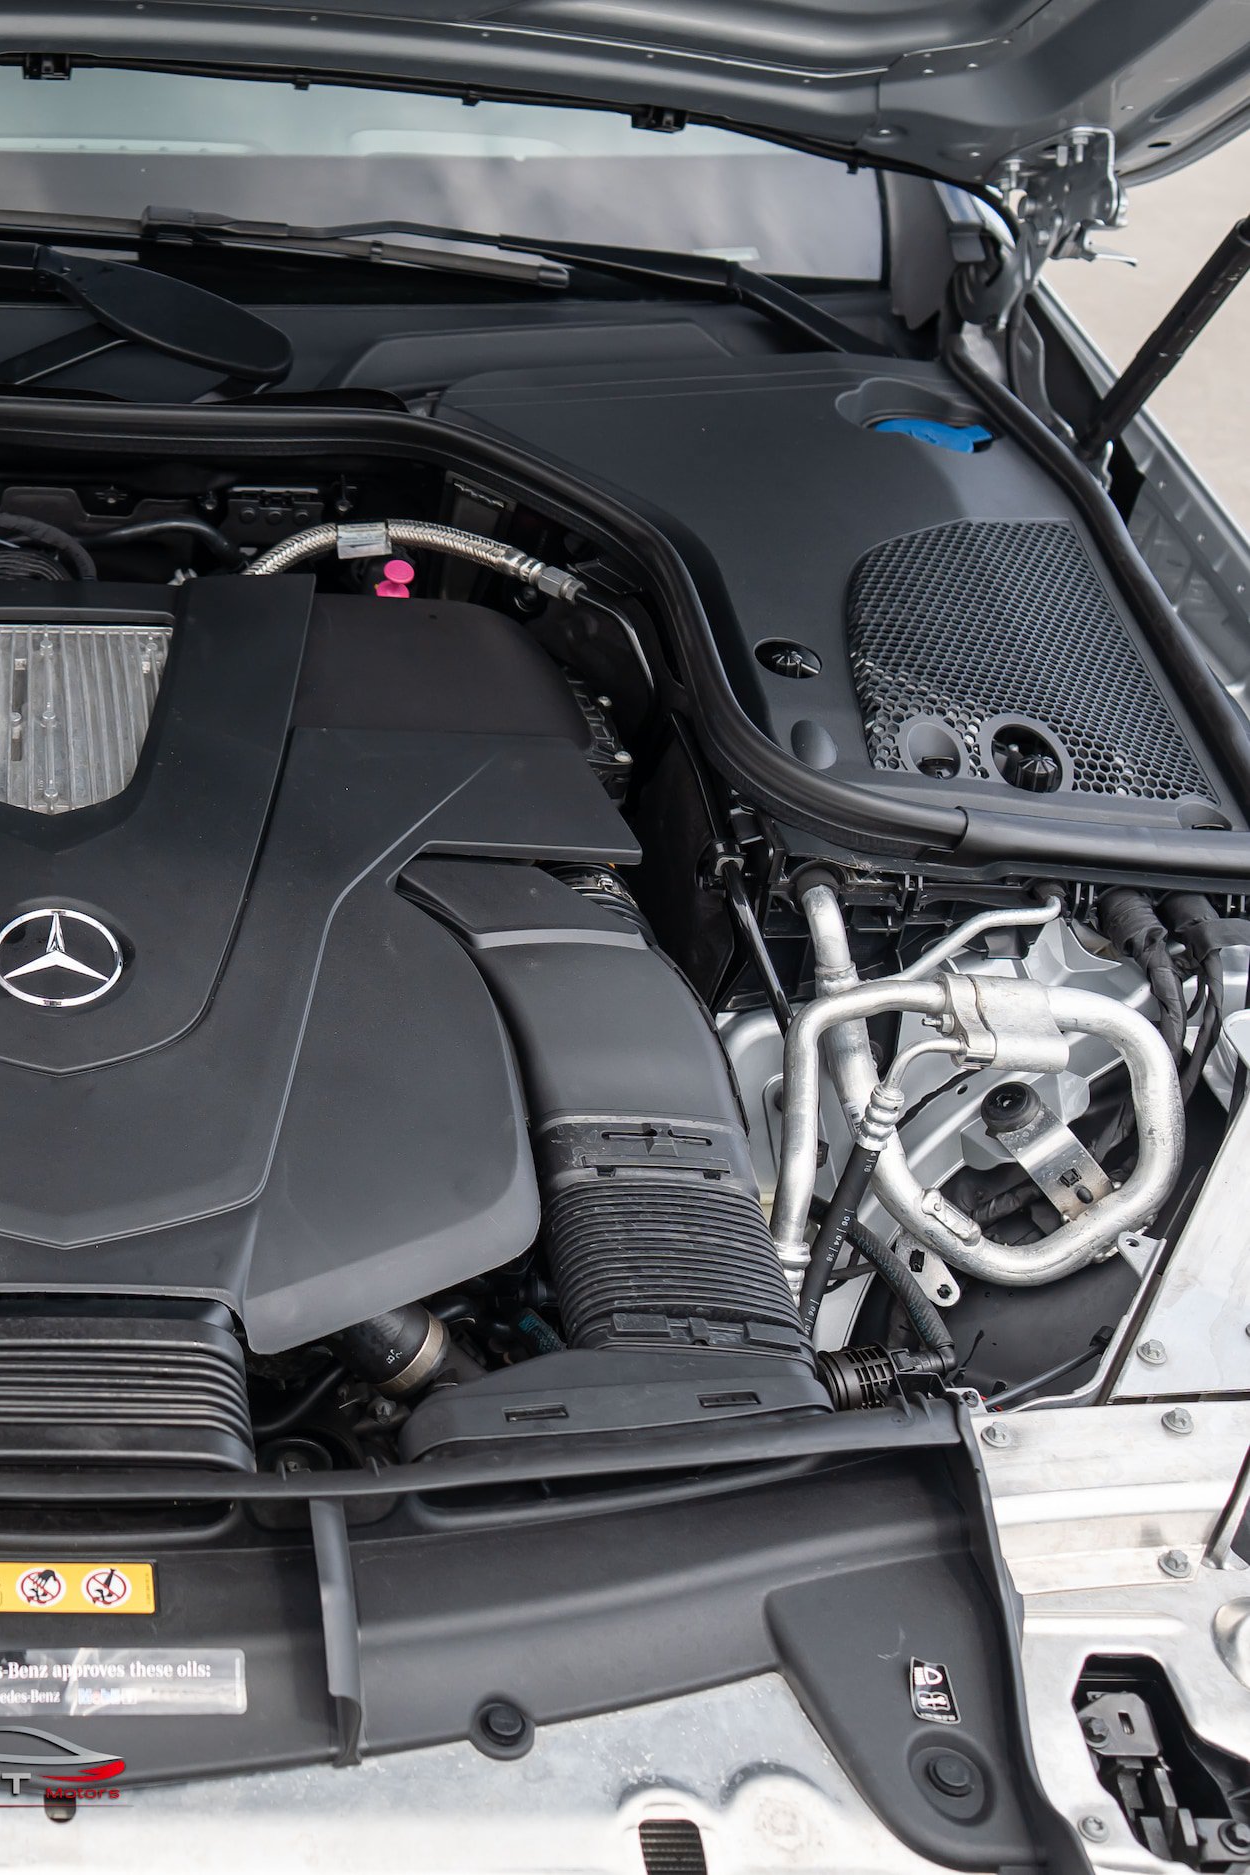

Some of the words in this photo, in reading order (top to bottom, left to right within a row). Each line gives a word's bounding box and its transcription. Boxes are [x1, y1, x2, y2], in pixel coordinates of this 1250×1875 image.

[52, 1663, 126, 1682] approves
[129, 1660, 174, 1678] these
[176, 1660, 212, 1678] oils:
